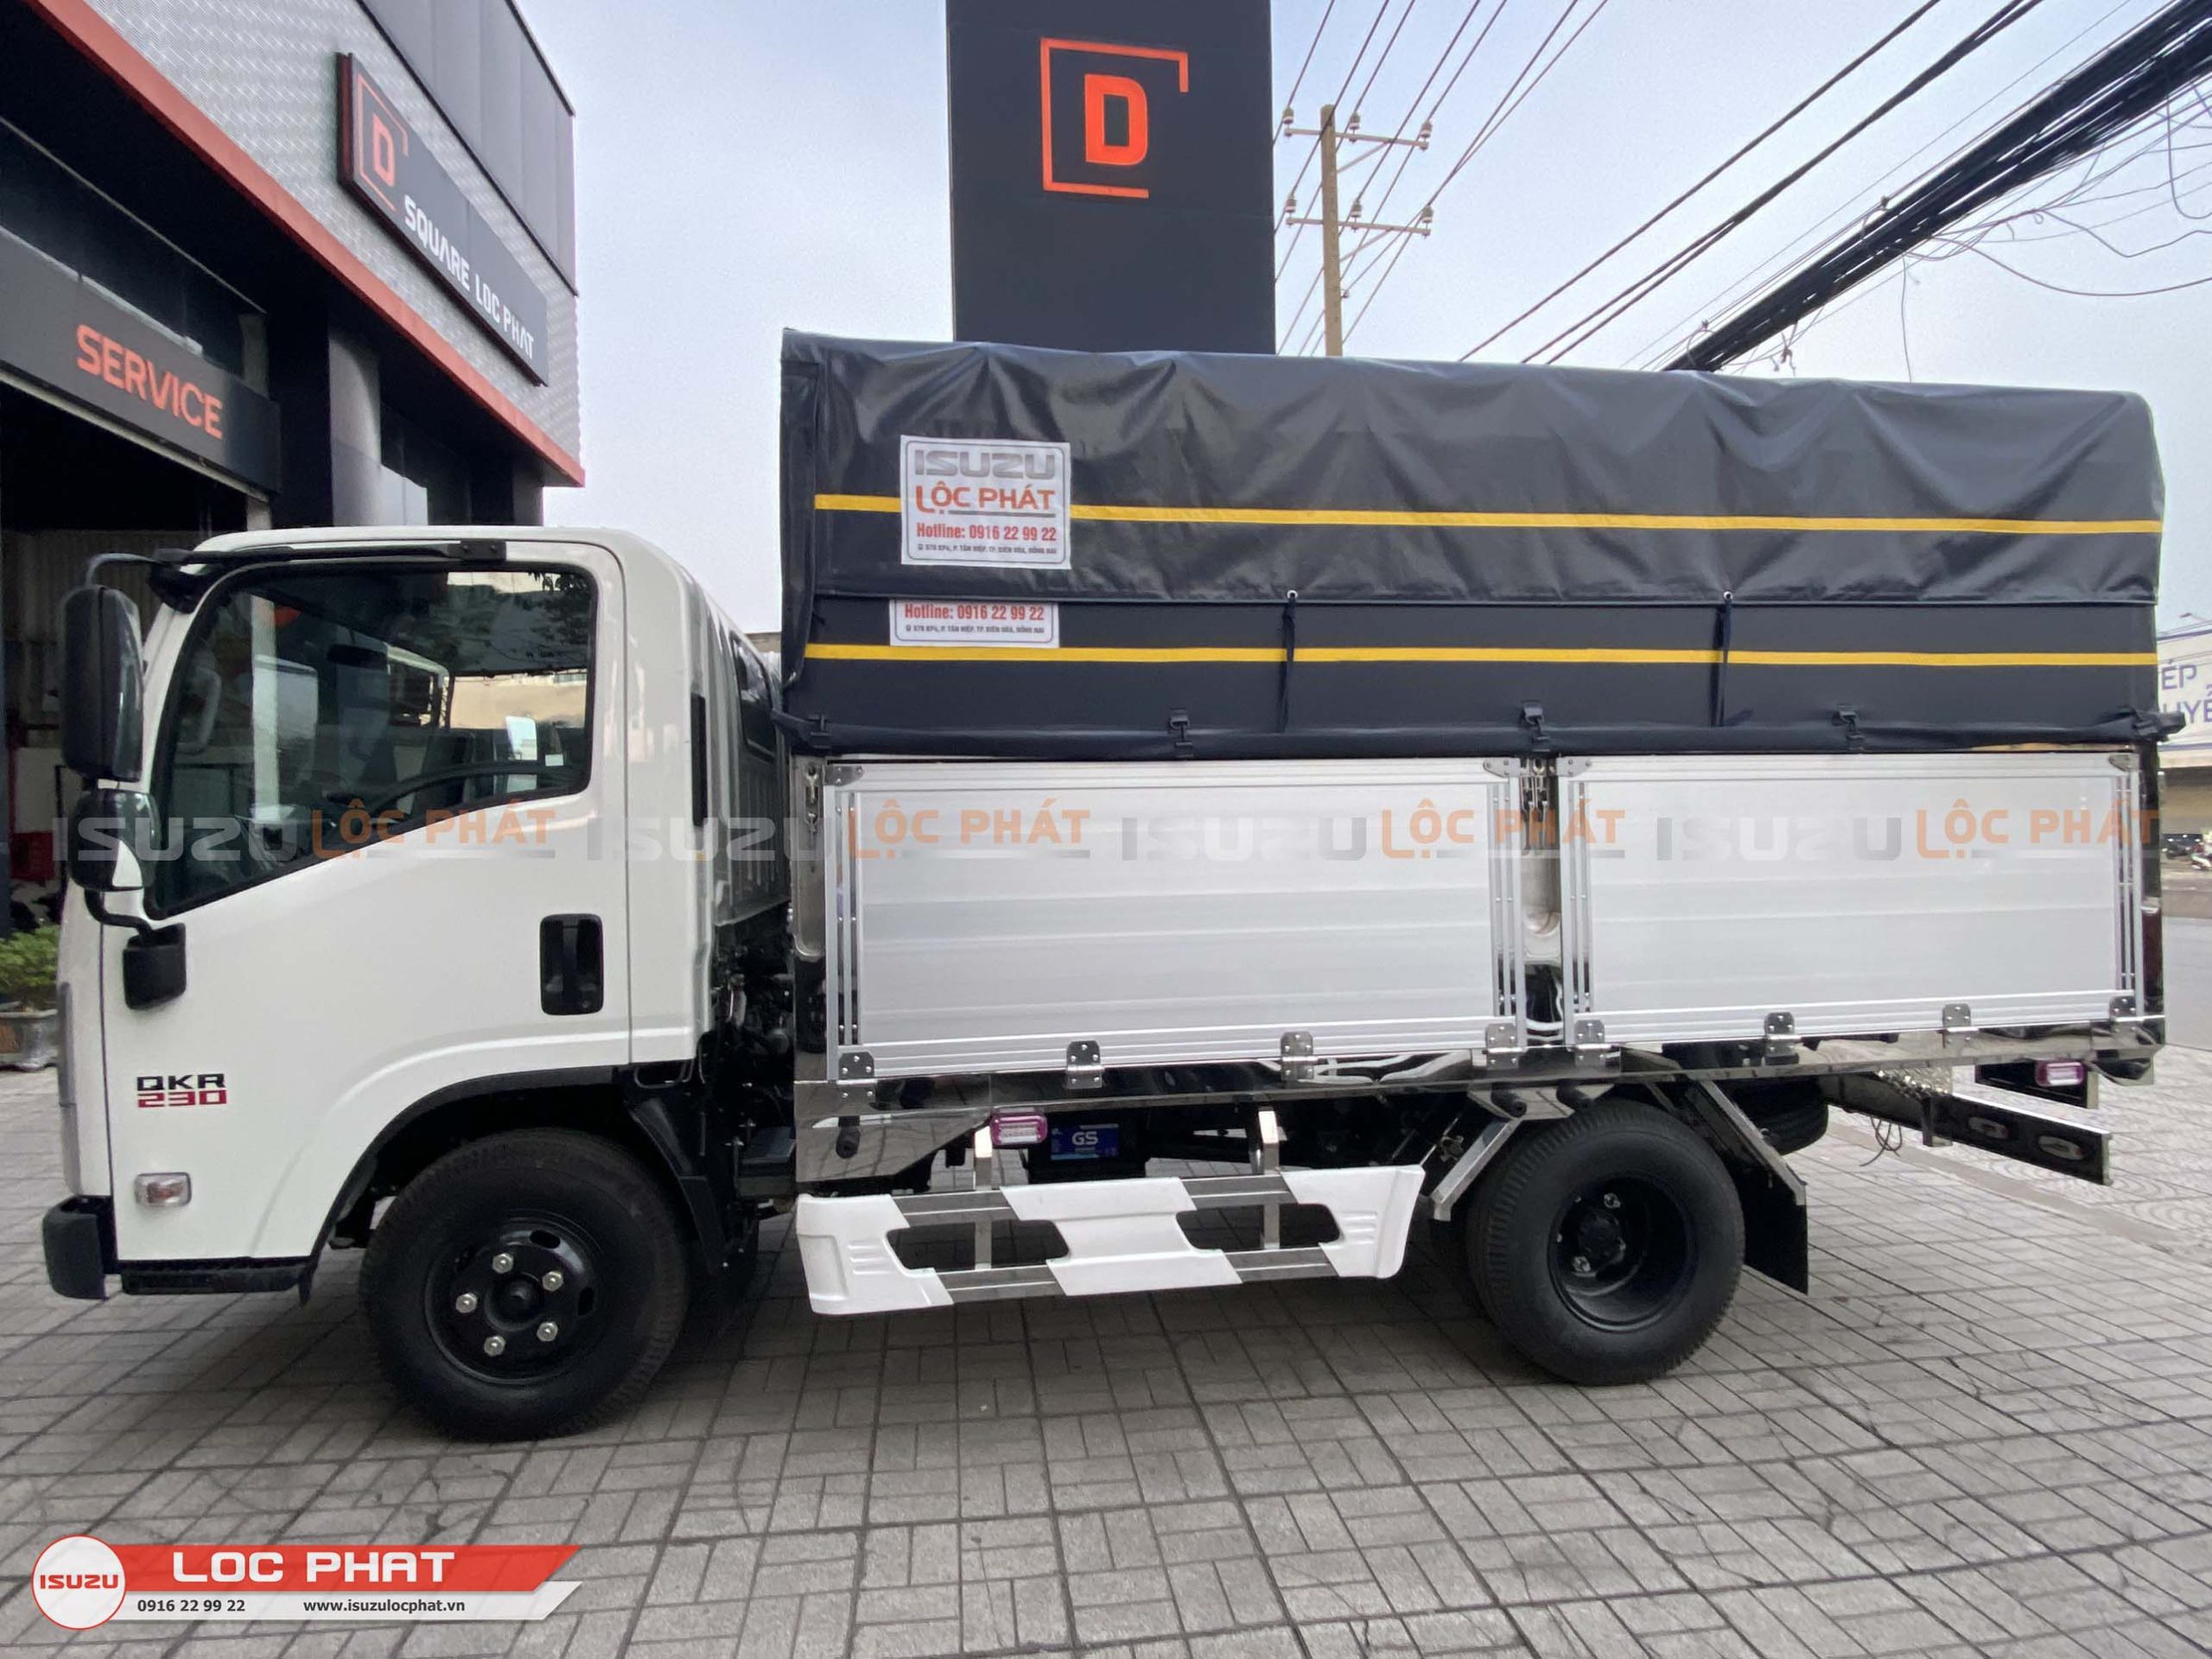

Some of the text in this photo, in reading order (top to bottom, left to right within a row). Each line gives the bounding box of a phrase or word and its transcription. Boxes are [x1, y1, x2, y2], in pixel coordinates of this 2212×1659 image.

[1084, 73, 1147, 165] D
[373, 112, 395, 187] D
[404, 194, 534, 359] SQUARE LOC PHAT
[76, 324, 222, 439] SERVICE
[914, 449, 1055, 480] ISUZU
[916, 480, 1055, 514] LỘC PHÁT
[917, 523, 1057, 541] Hotline: 0916 22 99 22
[905, 604, 1045, 620] Hotline: 0916 22 99 22
[137, 1073, 226, 1091] QKR
[137, 1090, 227, 1108] 230
[1071, 1131, 1099, 1146] GS
